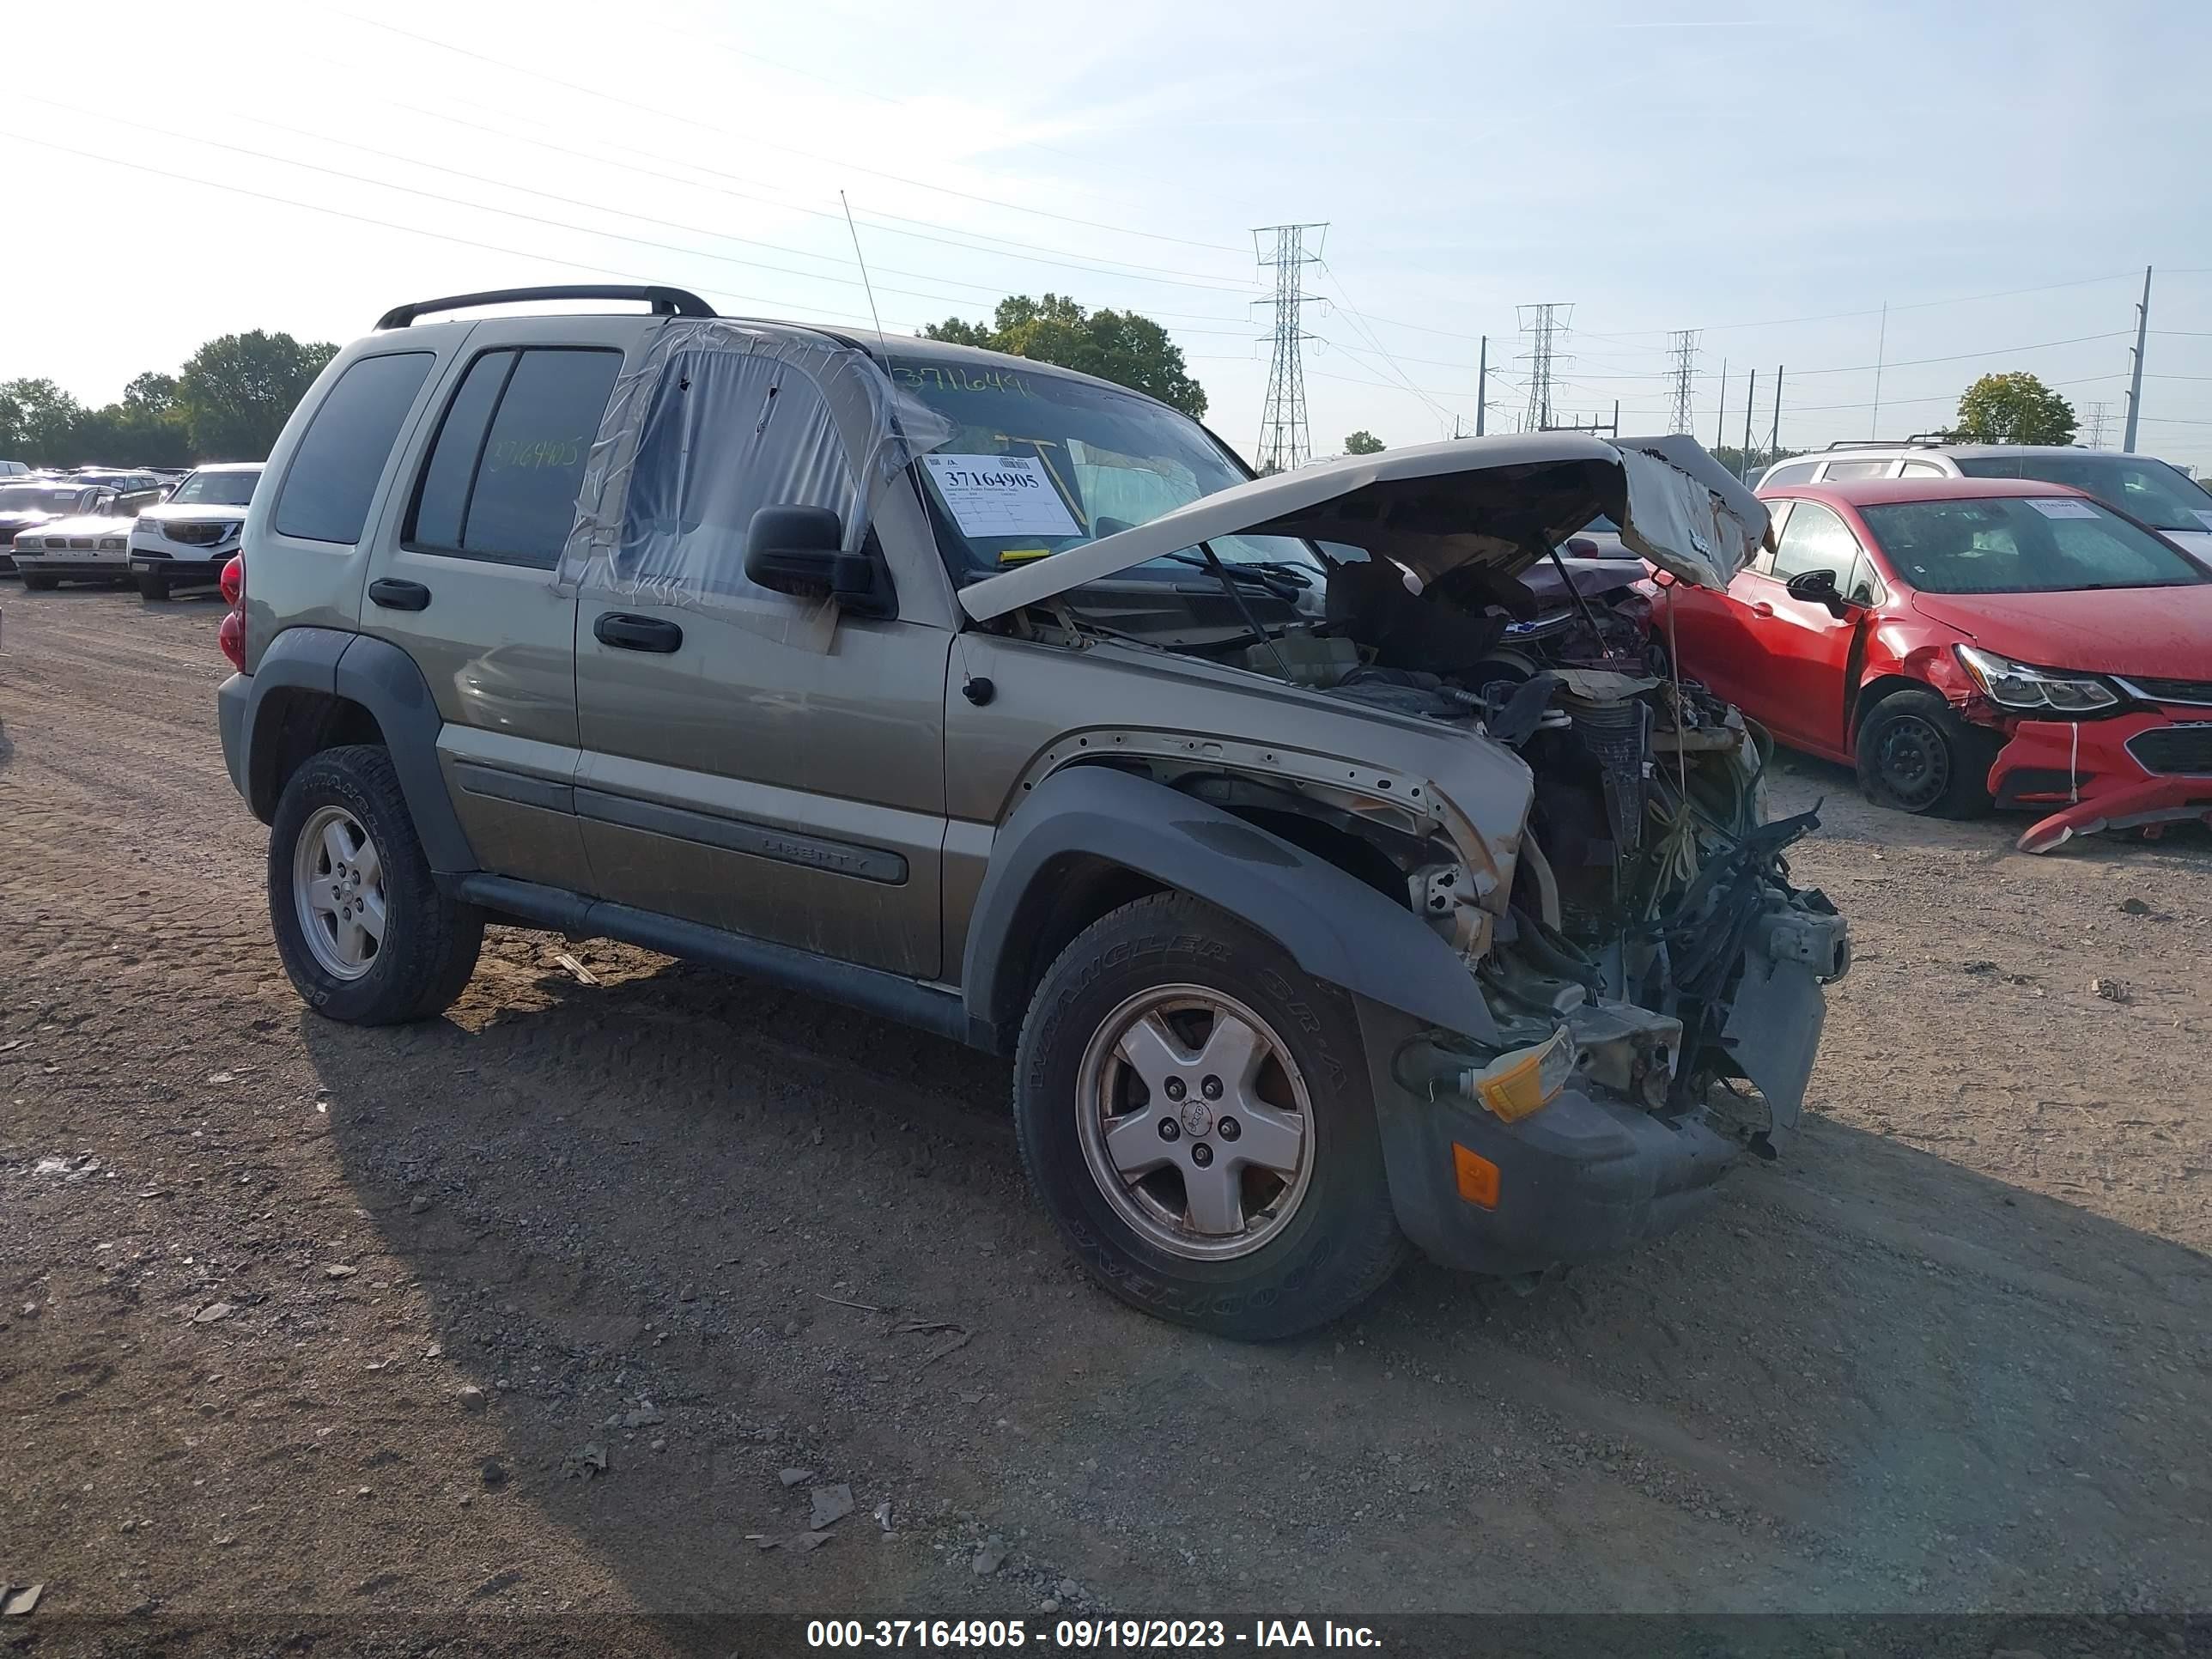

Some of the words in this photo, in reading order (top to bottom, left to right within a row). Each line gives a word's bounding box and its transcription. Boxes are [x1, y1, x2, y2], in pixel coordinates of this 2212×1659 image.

[945, 471, 1039, 489] 37164905
[762, 837, 869, 870] LIBERTY
[1030, 933, 1233, 1089] WRANGLER
[1188, 1105, 1203, 1133] Jeep
